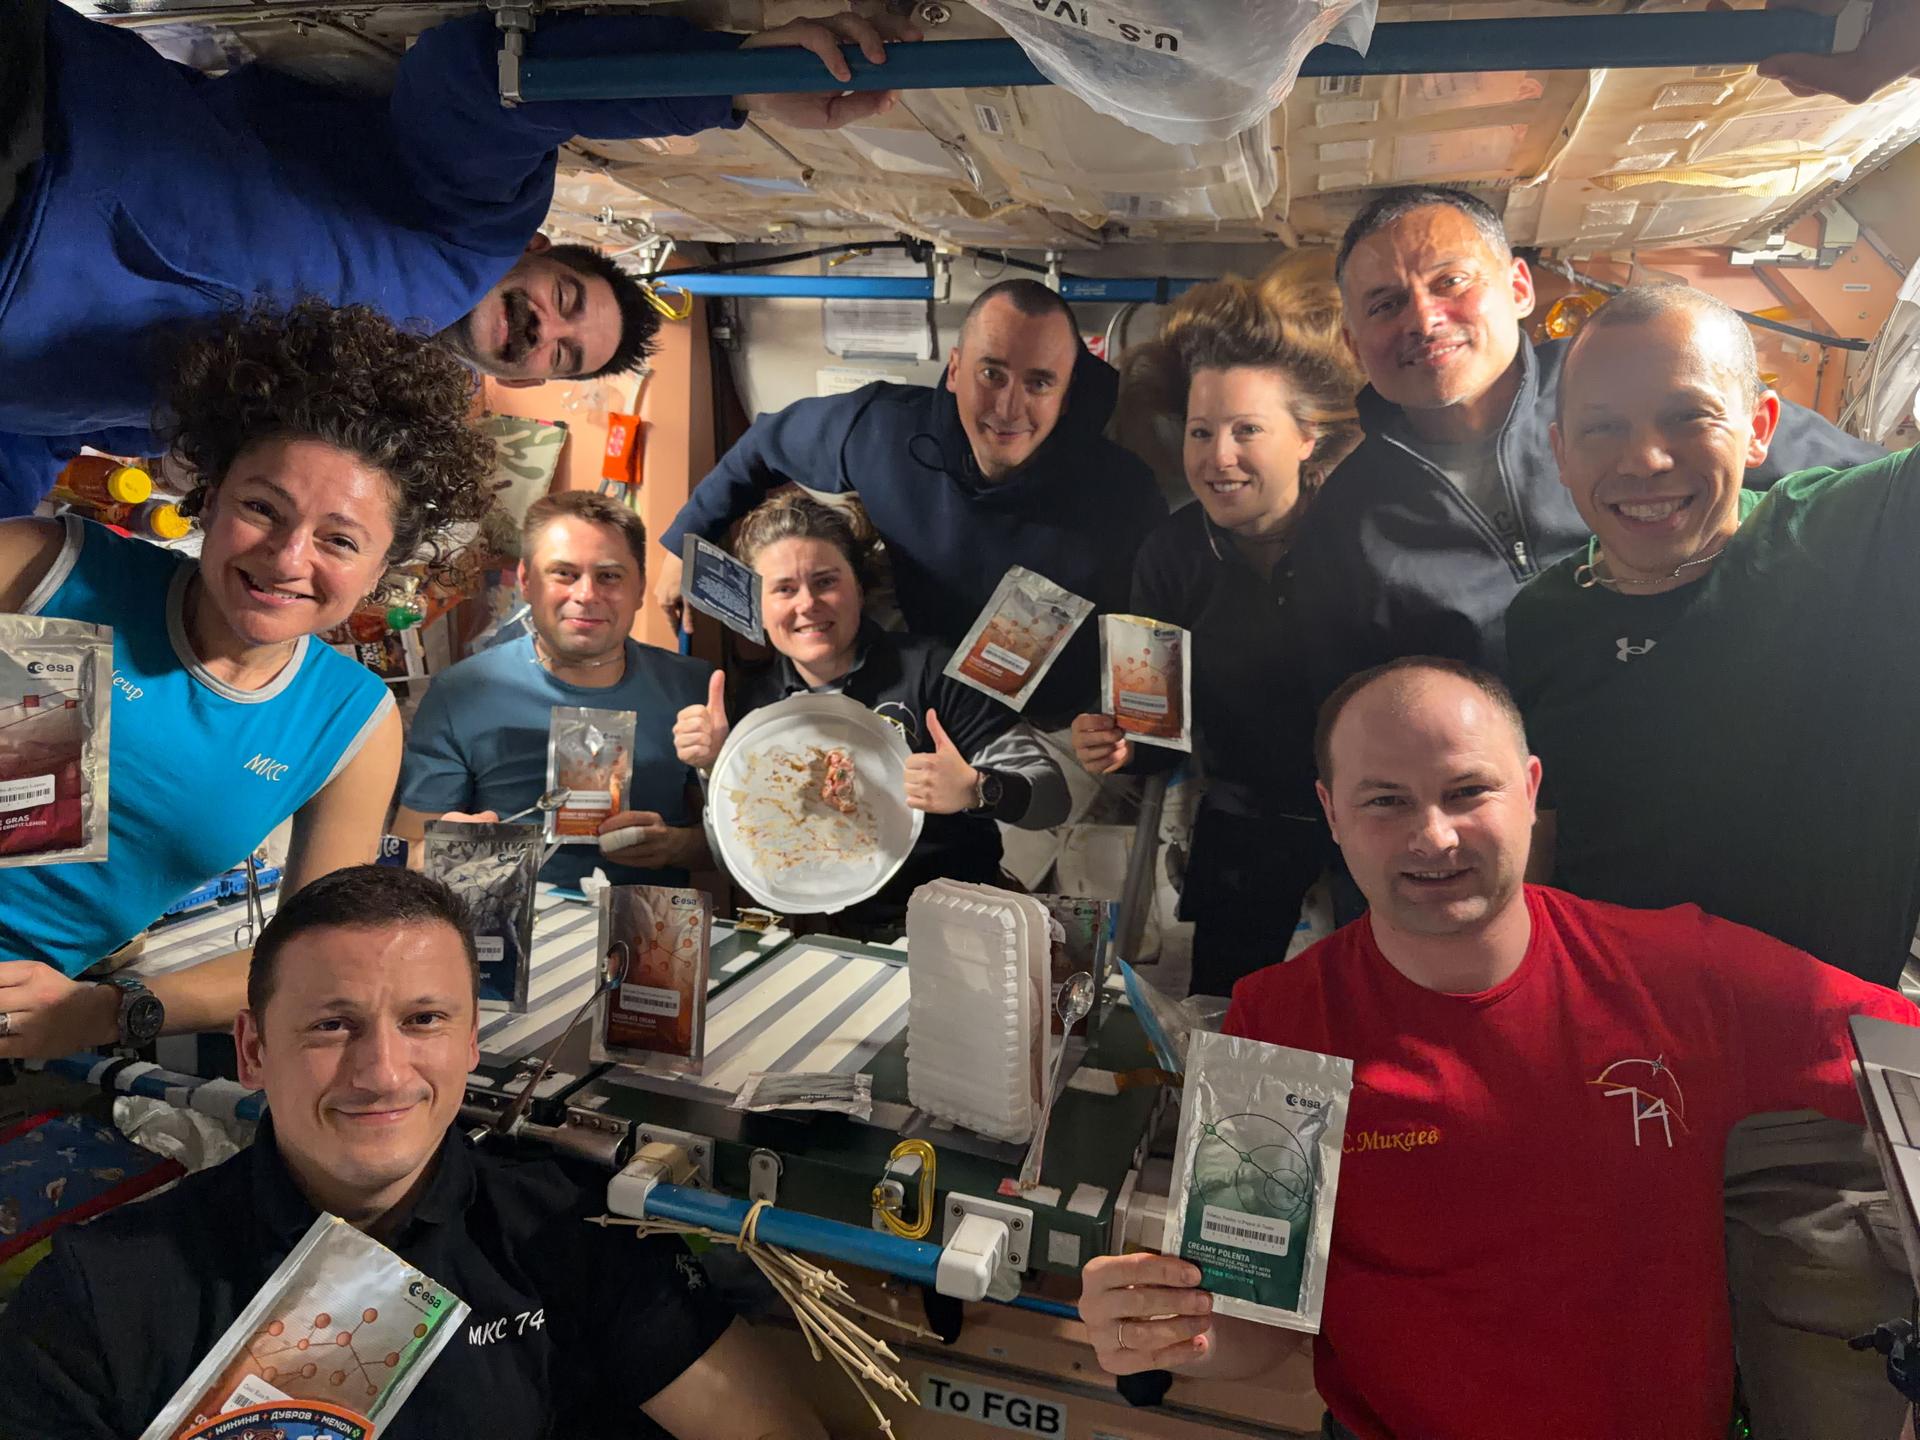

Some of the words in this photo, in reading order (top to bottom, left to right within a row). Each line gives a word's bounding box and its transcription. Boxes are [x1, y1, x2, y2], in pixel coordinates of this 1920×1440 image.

[1107, 18, 1178, 52] U.S.
[46, 663, 74, 673] esa
[5, 814, 30, 825] GRAS
[680, 898, 697, 906] esa
[1300, 1098, 1321, 1109] esa
[1357, 1126, 1440, 1152] Микаев
[1187, 1241, 1217, 1254] CREAMY
[1218, 1247, 1250, 1263] POLENTA
[421, 1291, 442, 1309] esa
[514, 1308, 546, 1336] 74
[927, 1378, 970, 1412] To
[982, 1391, 1060, 1434] FGB
[215, 1413, 260, 1435] КИКИНА
[270, 1410, 312, 1421] ДУБРОВ
[320, 1415, 353, 1434] MENON
